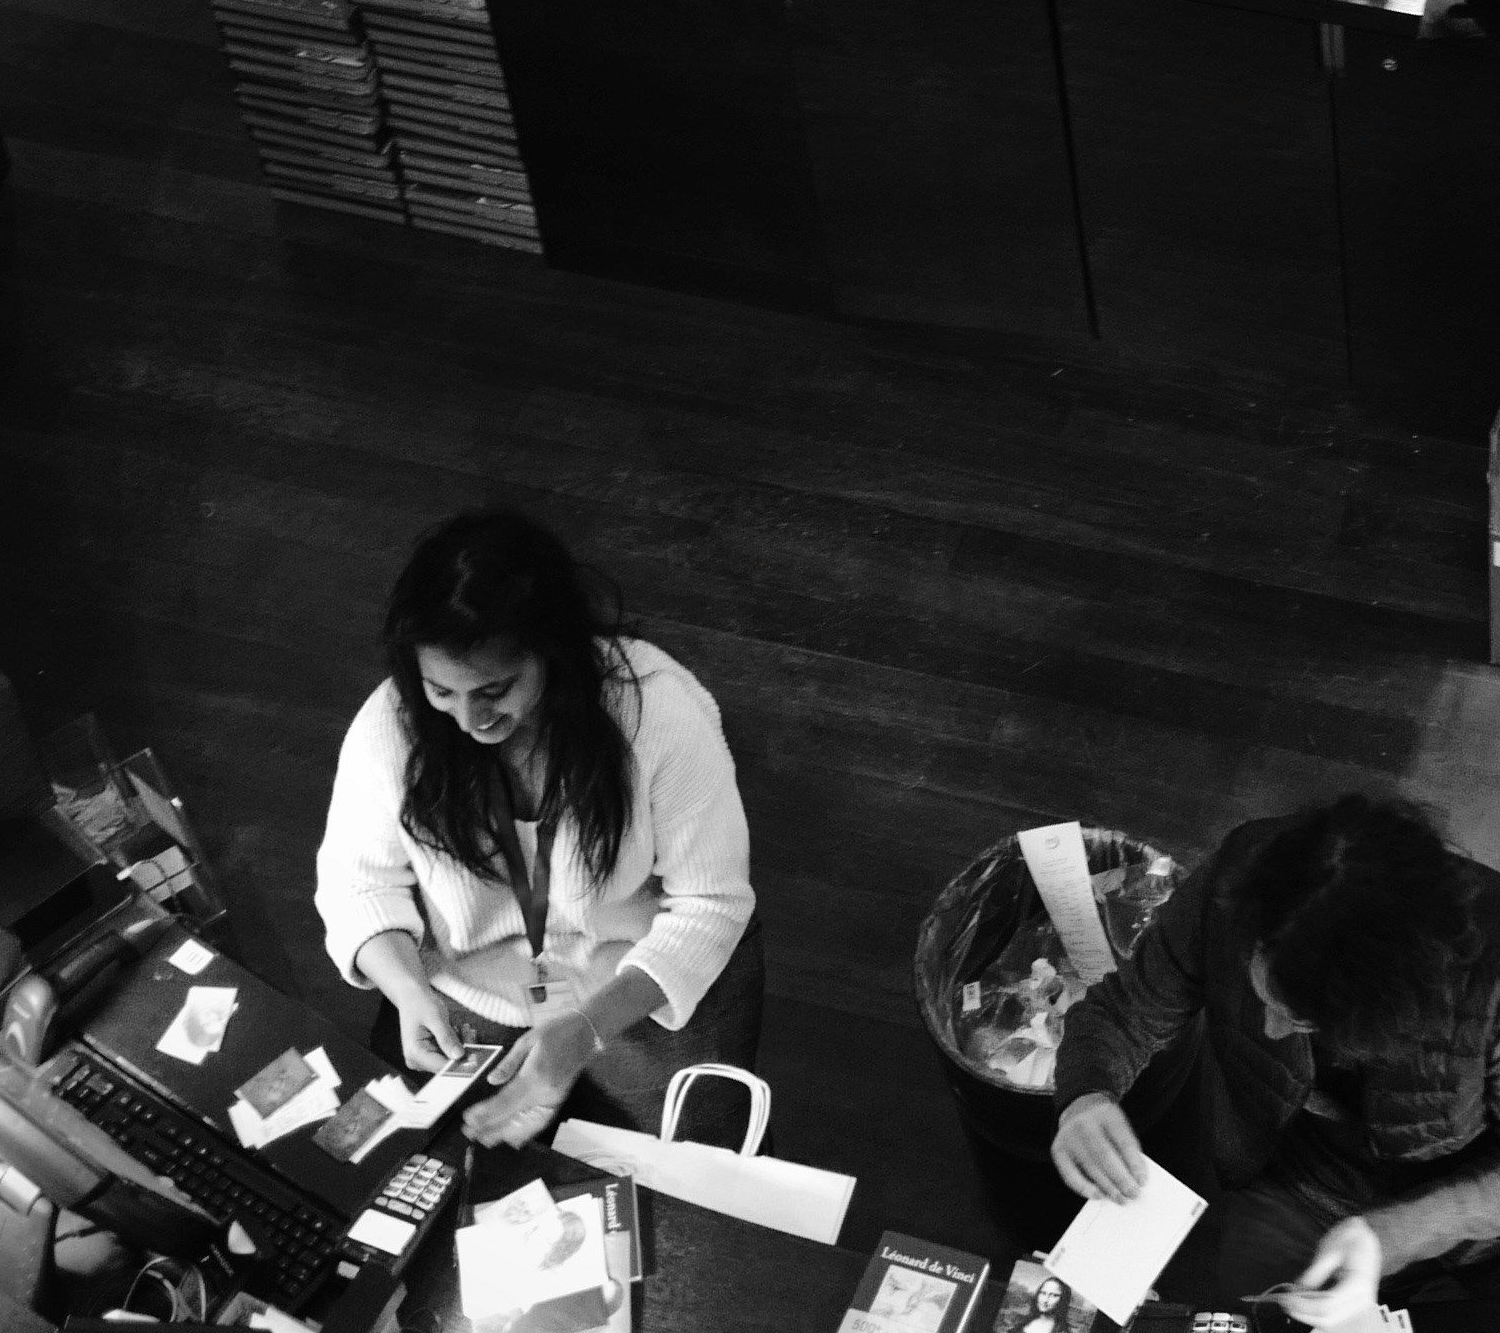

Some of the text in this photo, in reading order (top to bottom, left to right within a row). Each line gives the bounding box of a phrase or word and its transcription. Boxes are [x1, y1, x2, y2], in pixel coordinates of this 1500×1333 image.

[605, 1182, 621, 1227] Léonard
[880, 1246, 975, 1283] Léonard de Vinci
